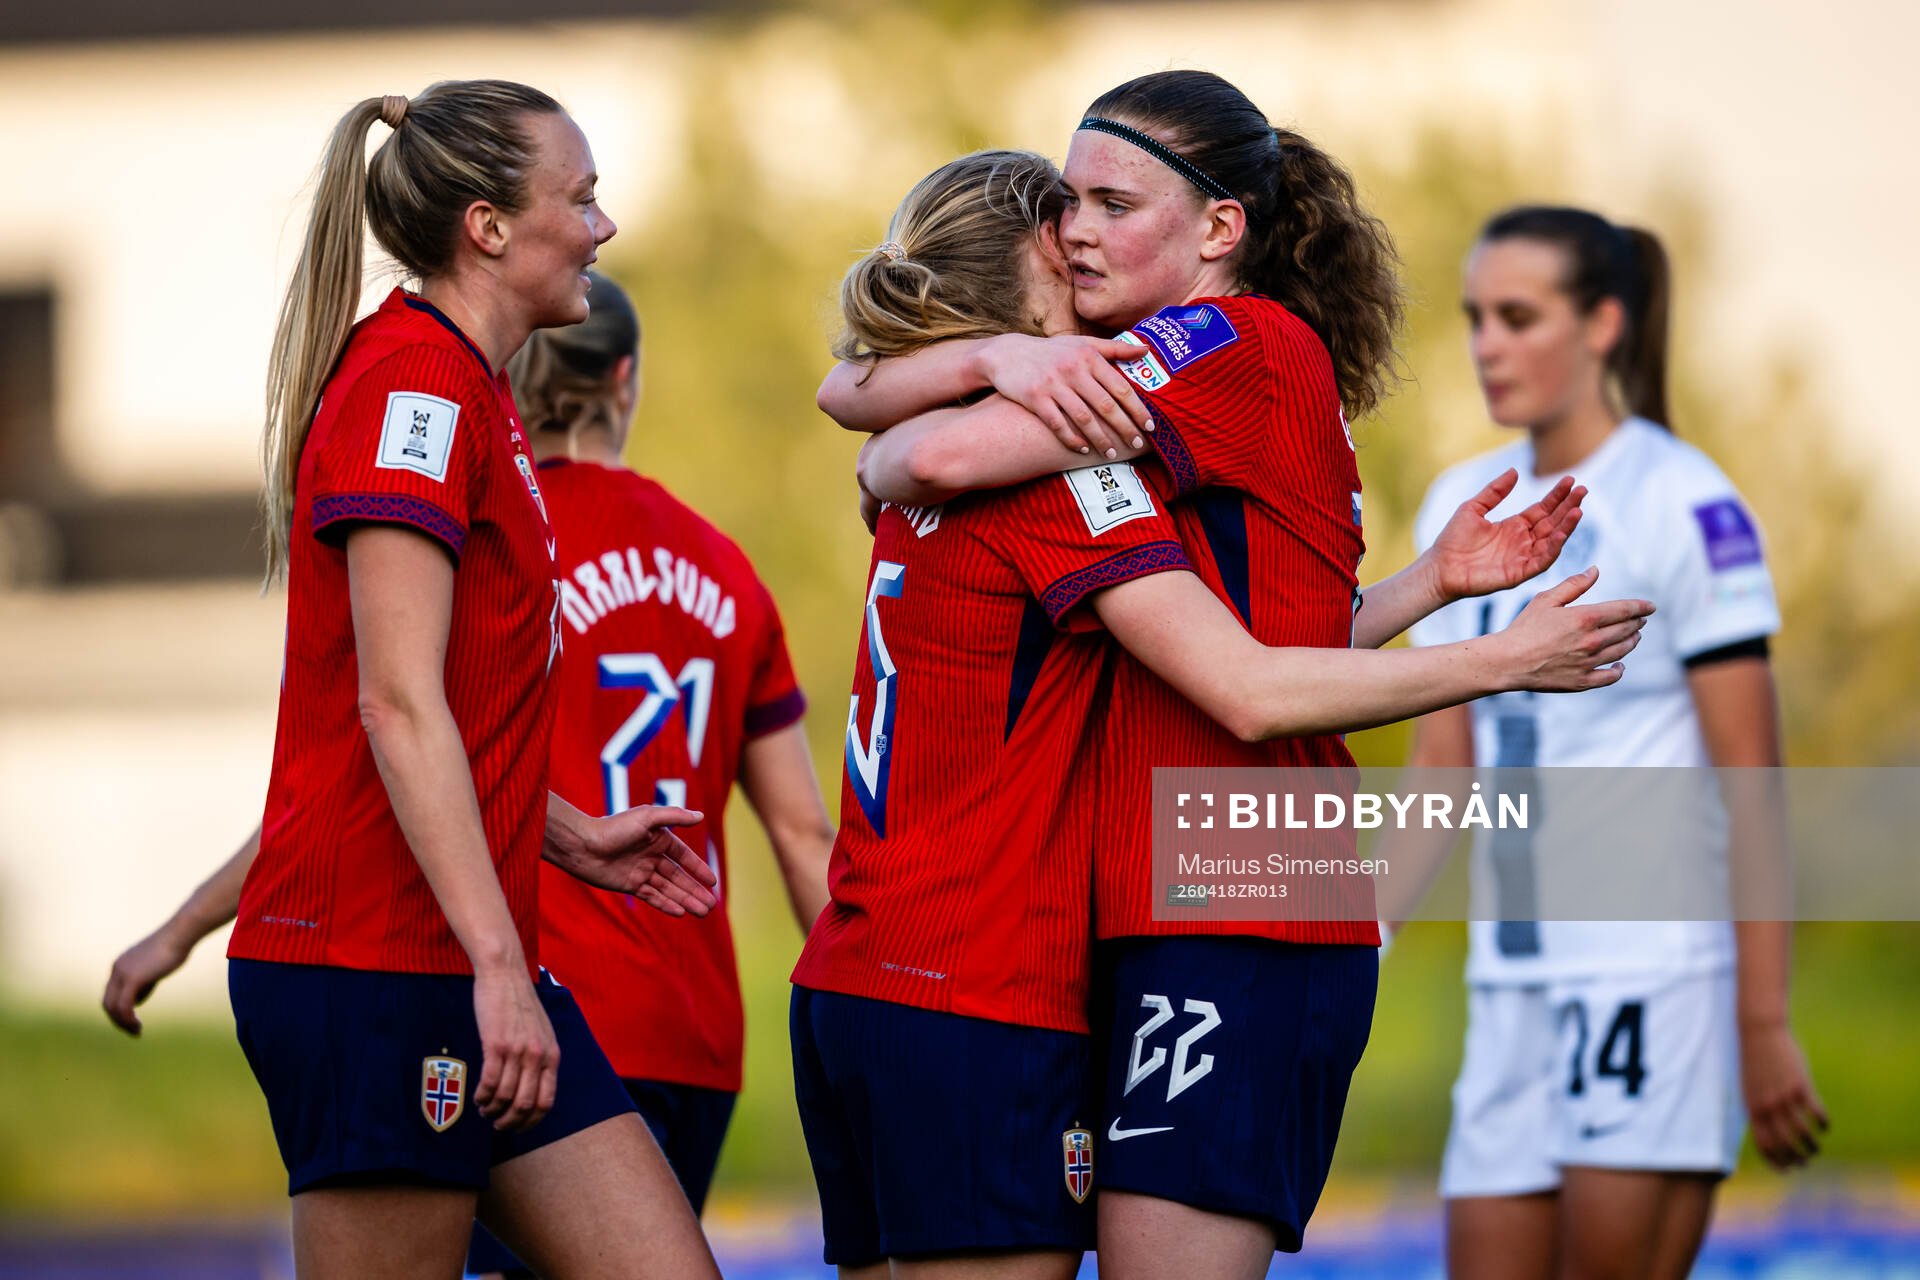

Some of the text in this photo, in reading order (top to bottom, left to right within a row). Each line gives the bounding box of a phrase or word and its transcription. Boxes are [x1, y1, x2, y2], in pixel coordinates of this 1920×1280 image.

[1141, 321, 1184, 361] QUALIFIERS
[1148, 316, 1192, 355] EUROPEAN
[845, 560, 906, 840] 5
[598, 652, 721, 902] 21
[1123, 994, 1222, 1103] 22
